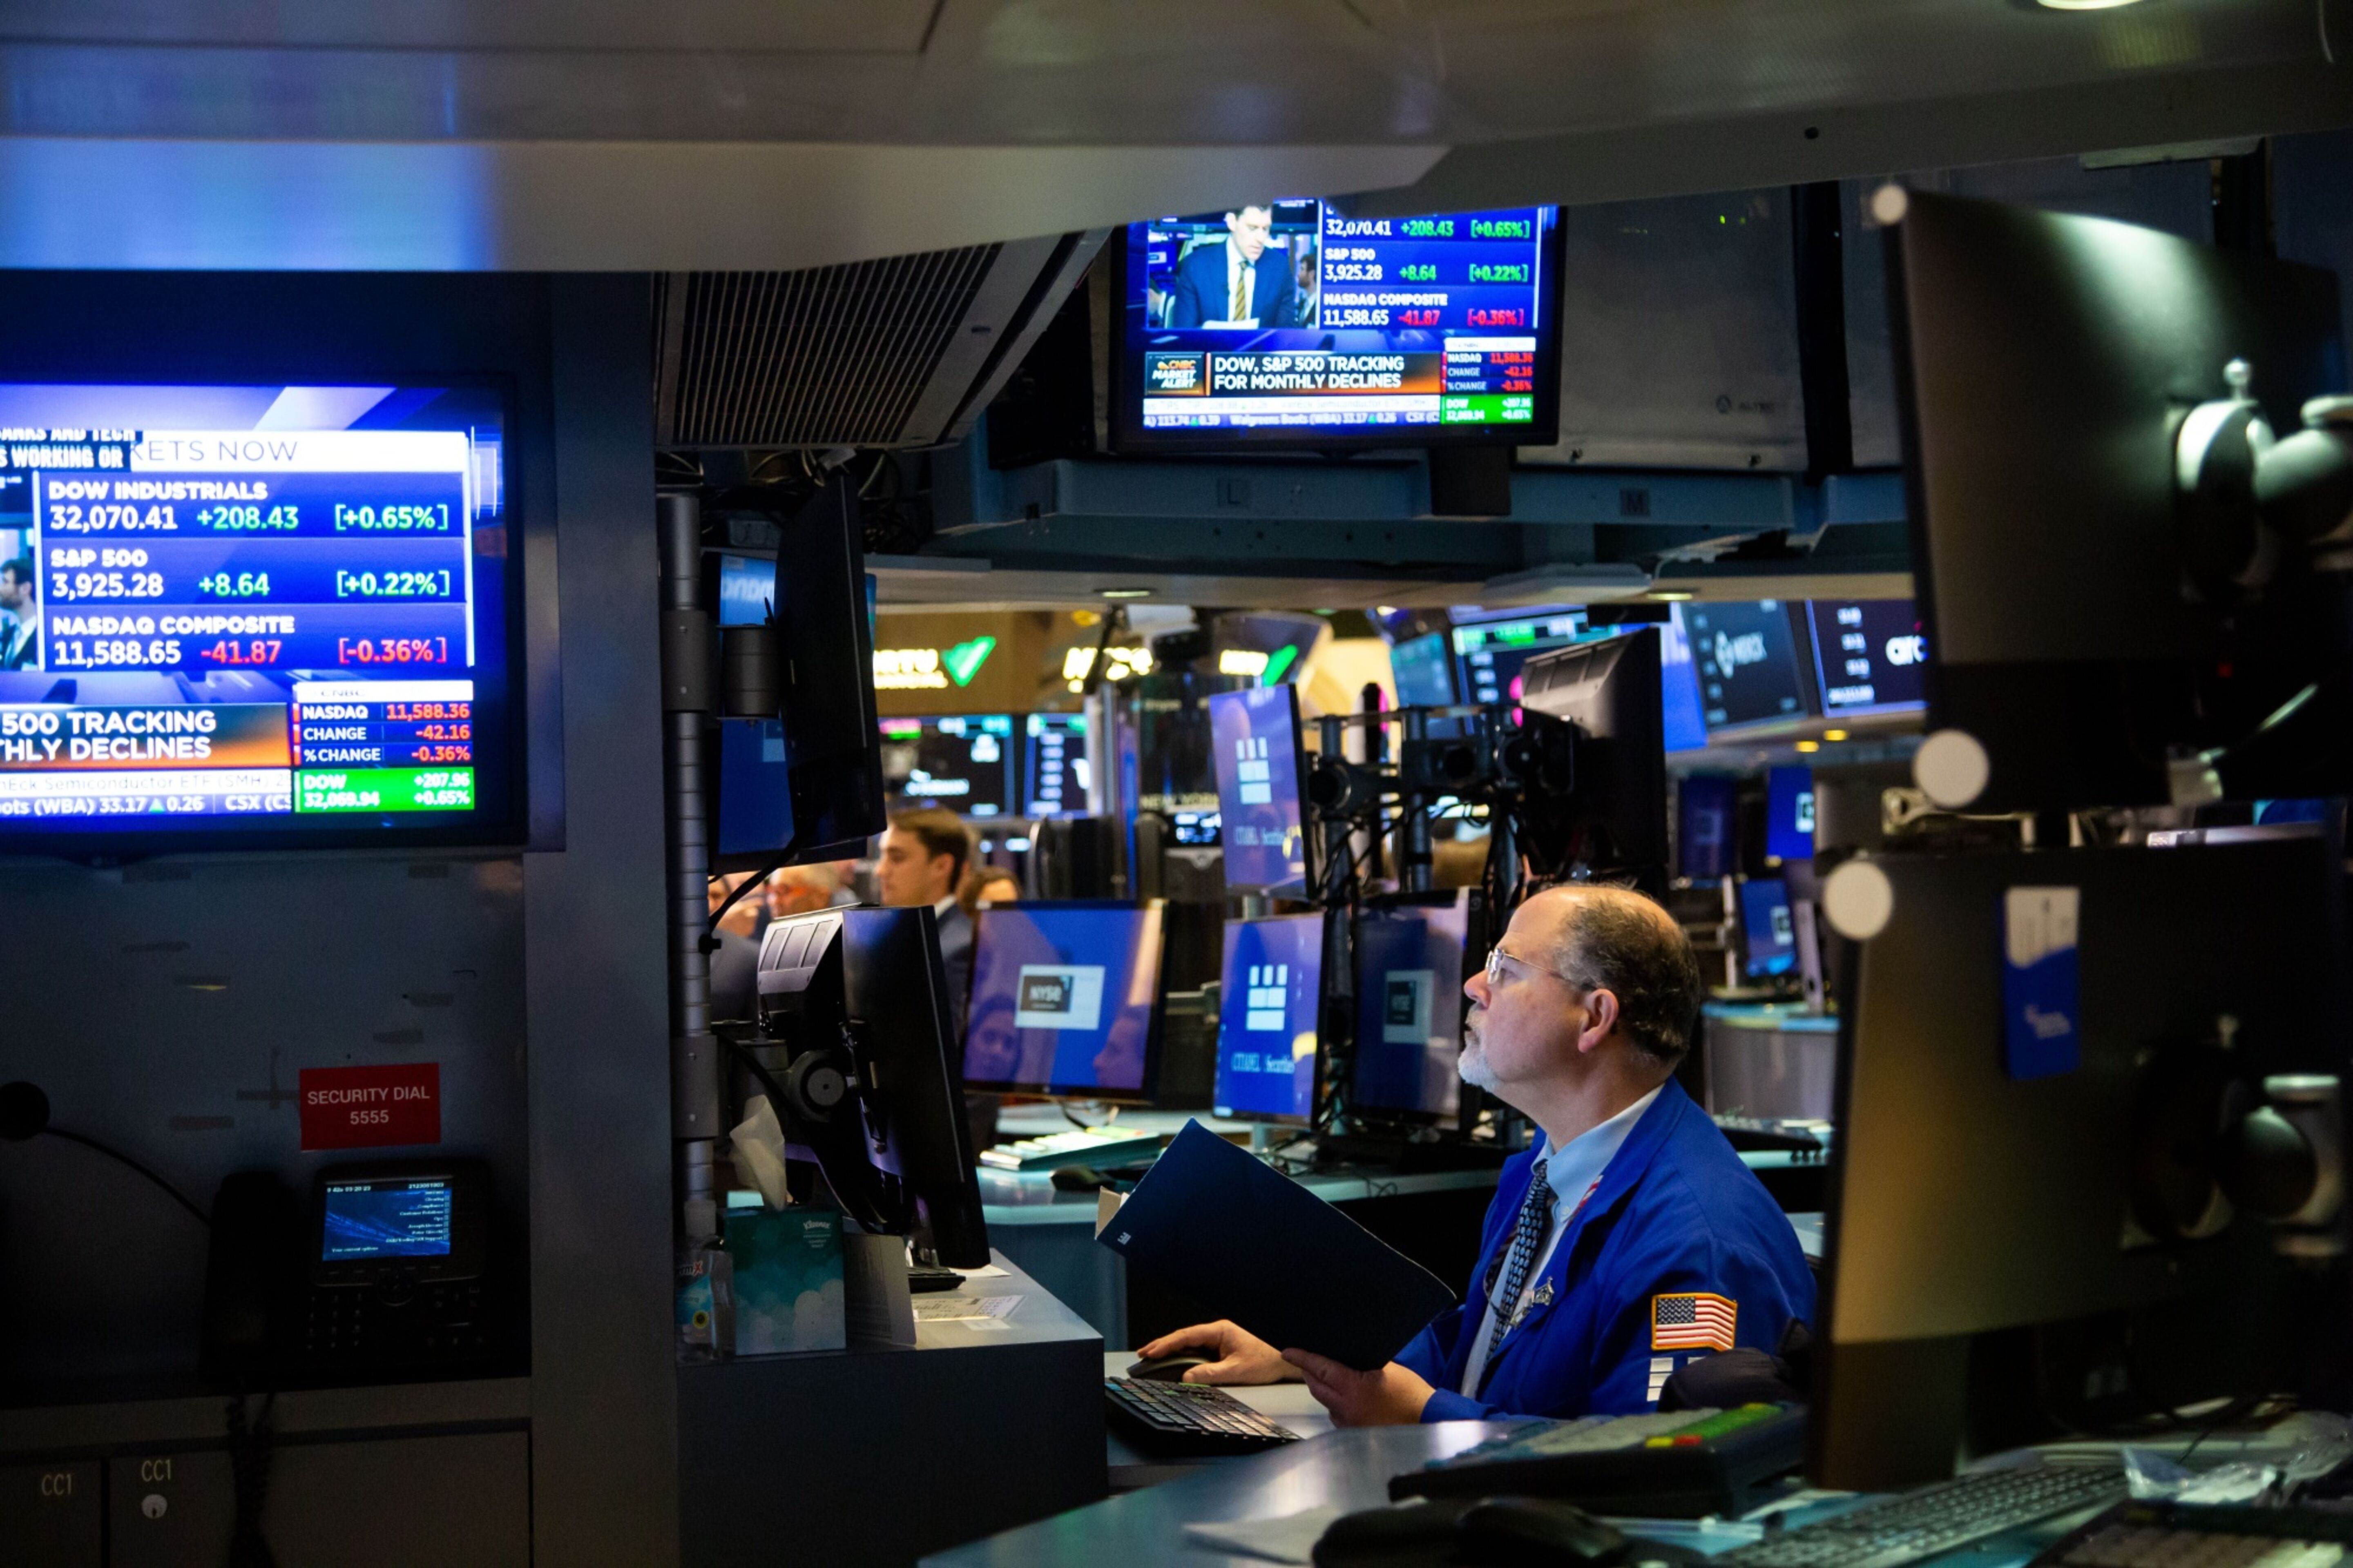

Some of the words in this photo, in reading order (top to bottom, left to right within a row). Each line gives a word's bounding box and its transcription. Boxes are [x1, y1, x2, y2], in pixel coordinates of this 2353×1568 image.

[1326, 219, 1391, 237] 32,070.41
[1401, 220, 1453, 236] +208.43
[1471, 219, 1530, 238] [+0.65%]
[1325, 248, 1349, 260] S&P
[1351, 248, 1375, 260] 500
[1325, 264, 1382, 281] 3,925.28
[1400, 264, 1436, 281] +8.64
[1470, 264, 1528, 282] [+0.22%]
[1324, 294, 1376, 306] NASDAQ
[1378, 293, 1448, 306] COMPOSITE
[1324, 309, 1389, 327] 11,588.65
[1398, 309, 1440, 325] -41.87
[1467, 308, 1524, 326] [-0.36%]
[1214, 357, 1258, 374] DOW,
[1262, 357, 1292, 371] S&P
[1295, 357, 1325, 371] 500
[1328, 356, 1404, 371] TRACKING
[1447, 353, 1482, 363] NASDAQ
[1152, 370, 1197, 380] MARKET
[1214, 375, 1247, 389] FOR
[1250, 374, 1326, 389] MONTHLY
[1328, 373, 1402, 388] DECLINES
[1448, 367, 1480, 377] CHANGE
[1161, 379, 1196, 388] ALERT
[1446, 399, 1469, 408] DOW
[0, 428, 47, 441] ANKS
[51, 428, 86, 441] AND
[11, 445, 94, 468] WORKING
[99, 445, 123, 468] OR
[219, 441, 297, 461] NOW
[49, 482, 109, 499] DOW
[114, 482, 268, 500] INDUSTRIALS
[49, 506, 178, 533] 32,070.41
[196, 506, 299, 529] +208.43
[335, 504, 449, 530] [+0.65%]
[50, 549, 97, 567] S&P
[101, 549, 148, 567] 500
[51, 572, 164, 600] 3,925.28
[199, 572, 270, 596] +8.64
[336, 570, 450, 596] [+0.22%]
[52, 616, 155, 635] NASDAQ
[160, 616, 295, 635] COMPOSITE
[54, 641, 181, 668] 11,588.65
[201, 640, 281, 663] -41.87
[338, 637, 447, 664] [-0.36%]
[302, 705, 368, 720] NASDAQ
[386, 704, 469, 722] 11,588.36
[2, 712, 60, 735] 500
[66, 710, 217, 734] TRACKING
[303, 727, 366, 741] CHANGE
[415, 725, 470, 740] -42.16
[70, 736, 212, 760] DECLINES
[411, 746, 470, 761] -0.36%
[44, 776, 173, 791] Semiconductor
[180, 775, 210, 789] ETF
[217, 774, 268, 791] (SMH)
[304, 774, 347, 789] DOW
[0, 798, 30, 814] ots
[33, 798, 94, 816] (WBA)
[99, 797, 147, 813] 33.17
[166, 796, 204, 812] 0.26
[225, 795, 262, 811] CSX
[414, 791, 470, 804] +0.65%
[308, 1087, 389, 1105] SECURITY
[393, 1086, 430, 1101] DIAL
[350, 1110, 389, 1125] 5555
[803, 1220, 832, 1231] Kleenex
[141, 1459, 172, 1482] CC1
[42, 1474, 73, 1496] CC1
